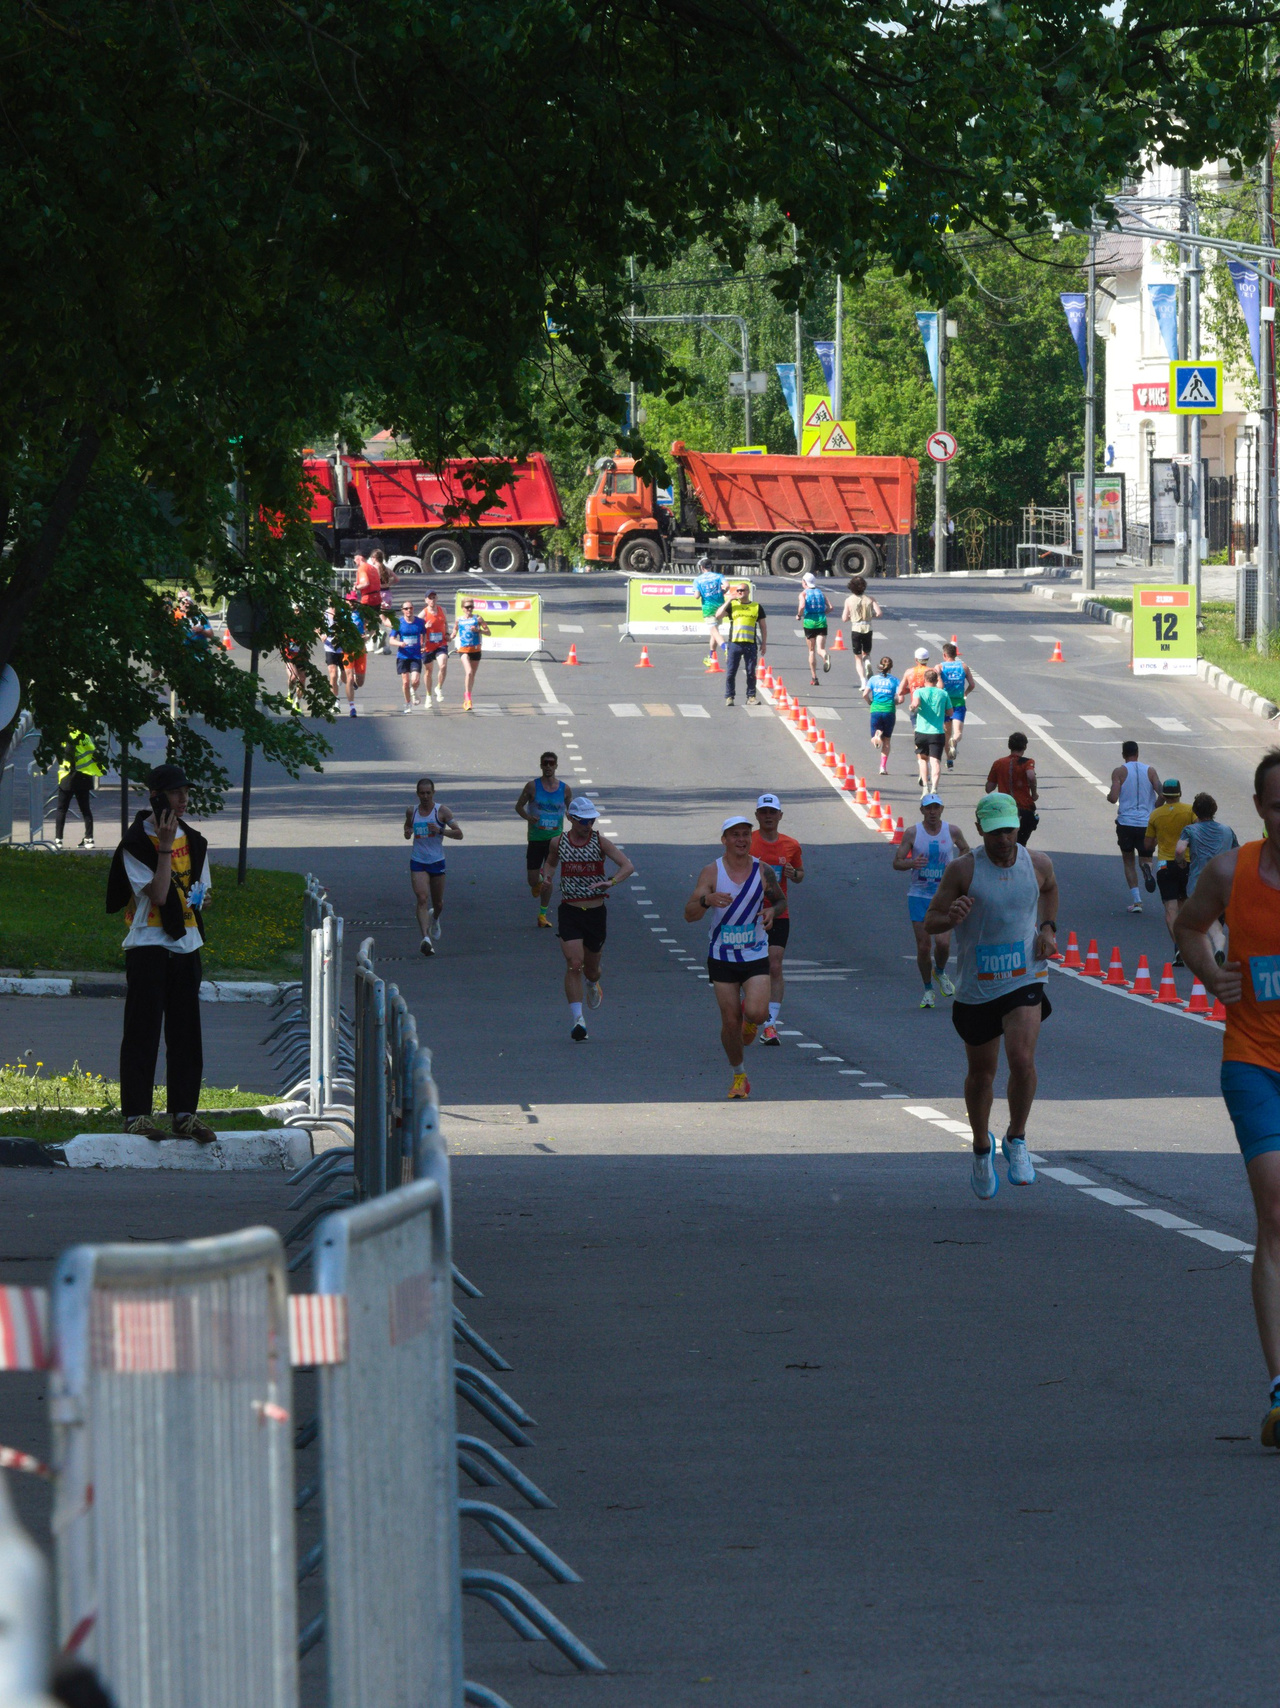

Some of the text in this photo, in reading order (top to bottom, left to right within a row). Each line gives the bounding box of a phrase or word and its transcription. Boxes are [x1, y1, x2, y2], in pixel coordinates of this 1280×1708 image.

[1239, 283, 1256, 293] 100
[1149, 388, 1168, 406] МКБ
[1152, 612, 1178, 641] 12
[722, 931, 754, 944] 50007
[981, 951, 1021, 972] 70170
